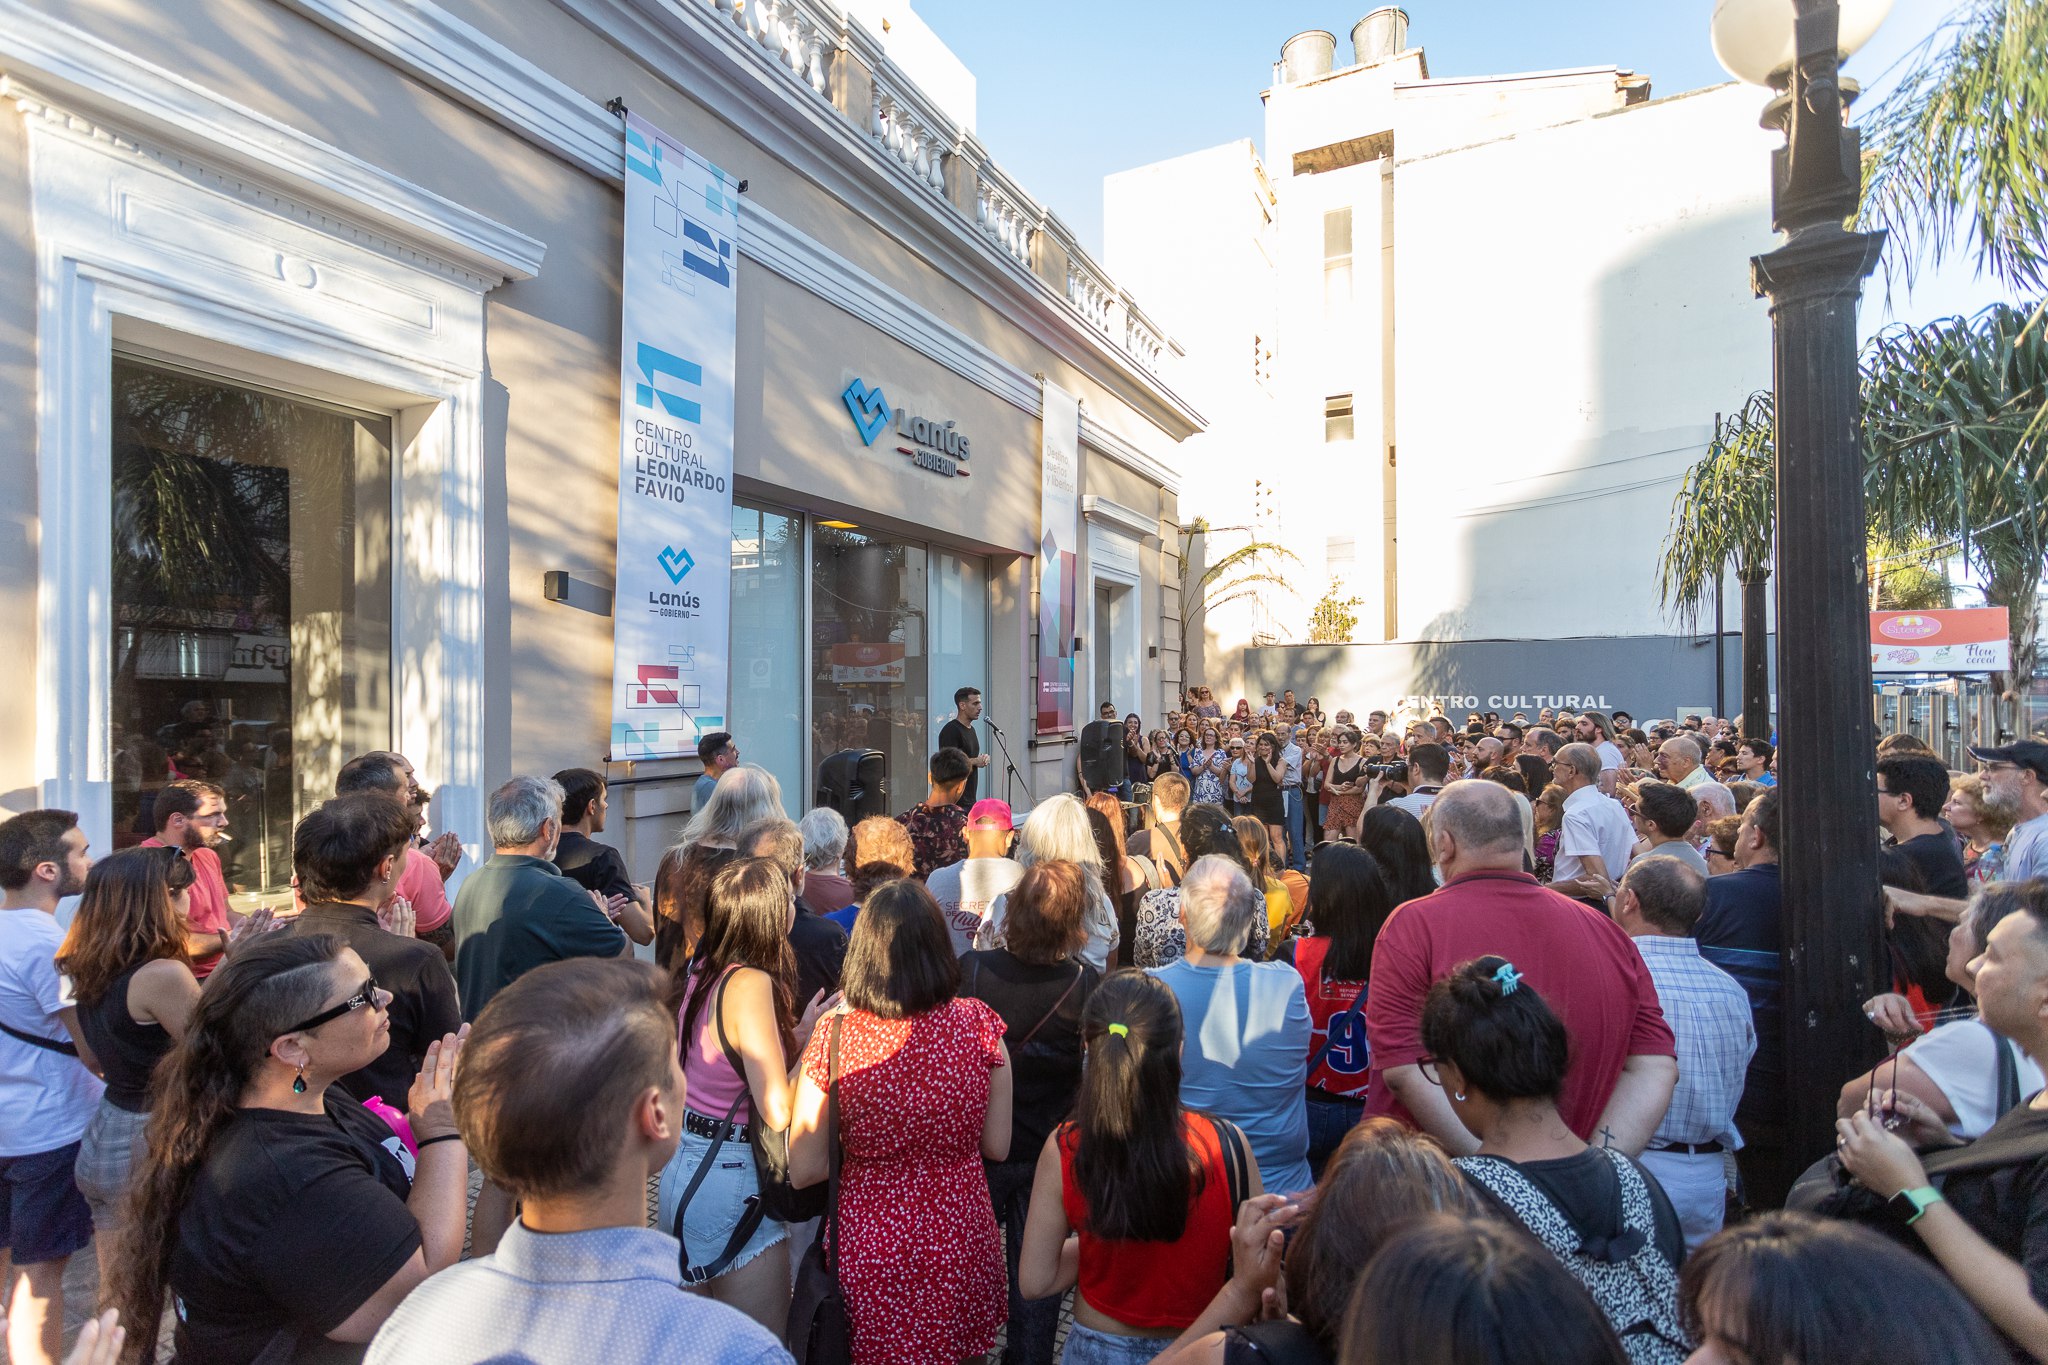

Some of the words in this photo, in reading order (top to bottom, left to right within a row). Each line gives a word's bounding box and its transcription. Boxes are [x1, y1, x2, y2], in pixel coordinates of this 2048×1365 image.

[636, 419, 692, 448] CENTRO
[896, 408, 971, 461] Lanús
[635, 437, 707, 471] CULTURAL
[912, 448, 958, 478] GOBIERNO
[636, 455, 725, 494] LEONARDO
[635, 476, 685, 504] FAVIO
[649, 590, 700, 609] Lanús
[659, 608, 690, 619] GOBIERNO
[1965, 643, 1996, 656] Flow
[1966, 656, 1996, 664] cereal
[1487, 695, 1612, 709] CULTURAL
[1327, 1010, 1371, 1075] 9
